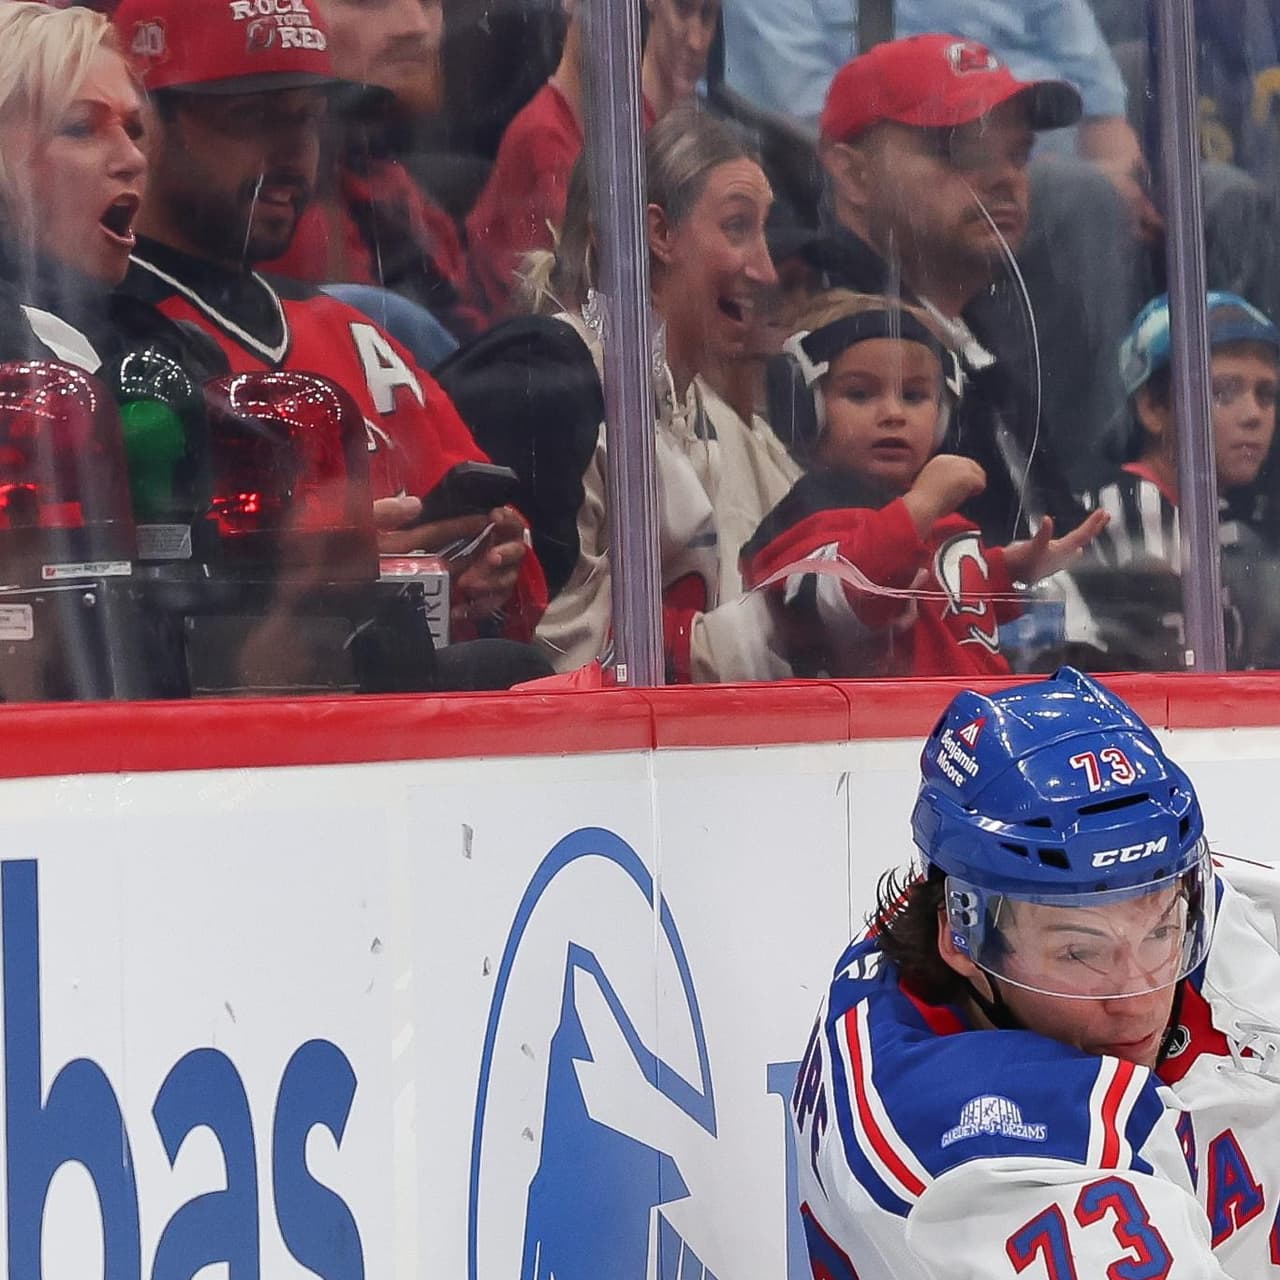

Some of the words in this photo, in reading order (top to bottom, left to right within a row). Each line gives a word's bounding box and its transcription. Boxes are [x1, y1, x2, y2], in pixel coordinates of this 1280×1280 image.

[277, 26, 327, 50] RED
[350, 321, 426, 416] A
[936, 749, 964, 788] Moore
[940, 728, 980, 777] Benjamin
[1069, 747, 1136, 793] 73
[1091, 835, 1169, 868] CCM
[1001, 1122, 1048, 1141] DREAMS
